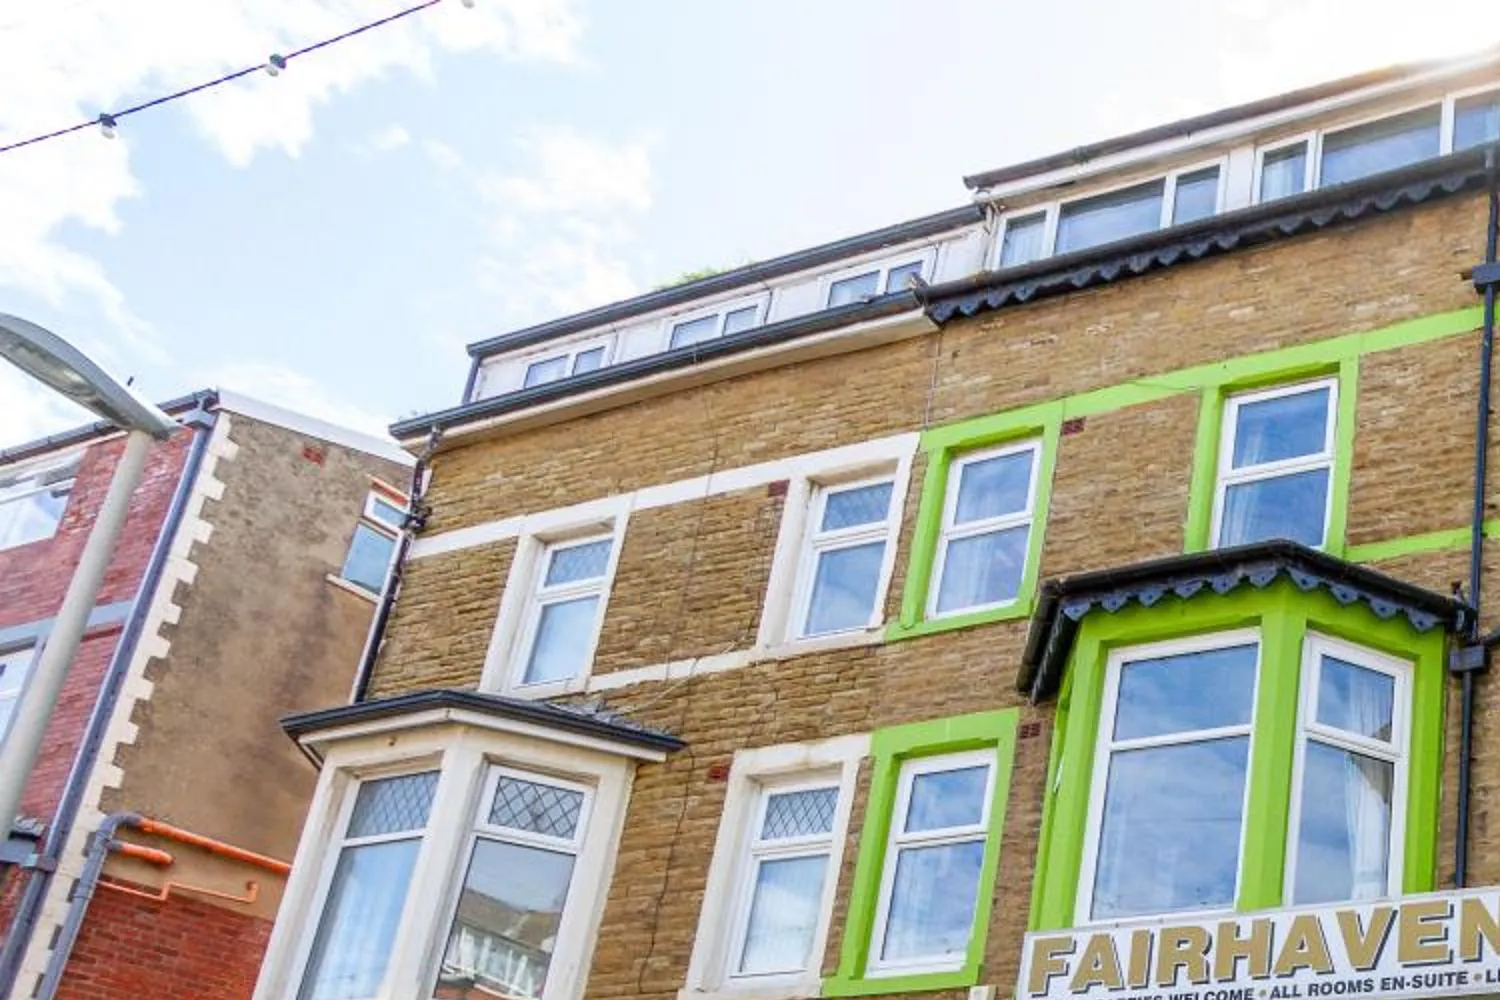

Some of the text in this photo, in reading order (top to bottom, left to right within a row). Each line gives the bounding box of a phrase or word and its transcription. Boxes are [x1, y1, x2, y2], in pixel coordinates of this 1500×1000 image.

[1269, 983, 1302, 1000] ALL
[1307, 978, 1375, 997] ROOMS
[1380, 970, 1470, 992] EN-SUITE
